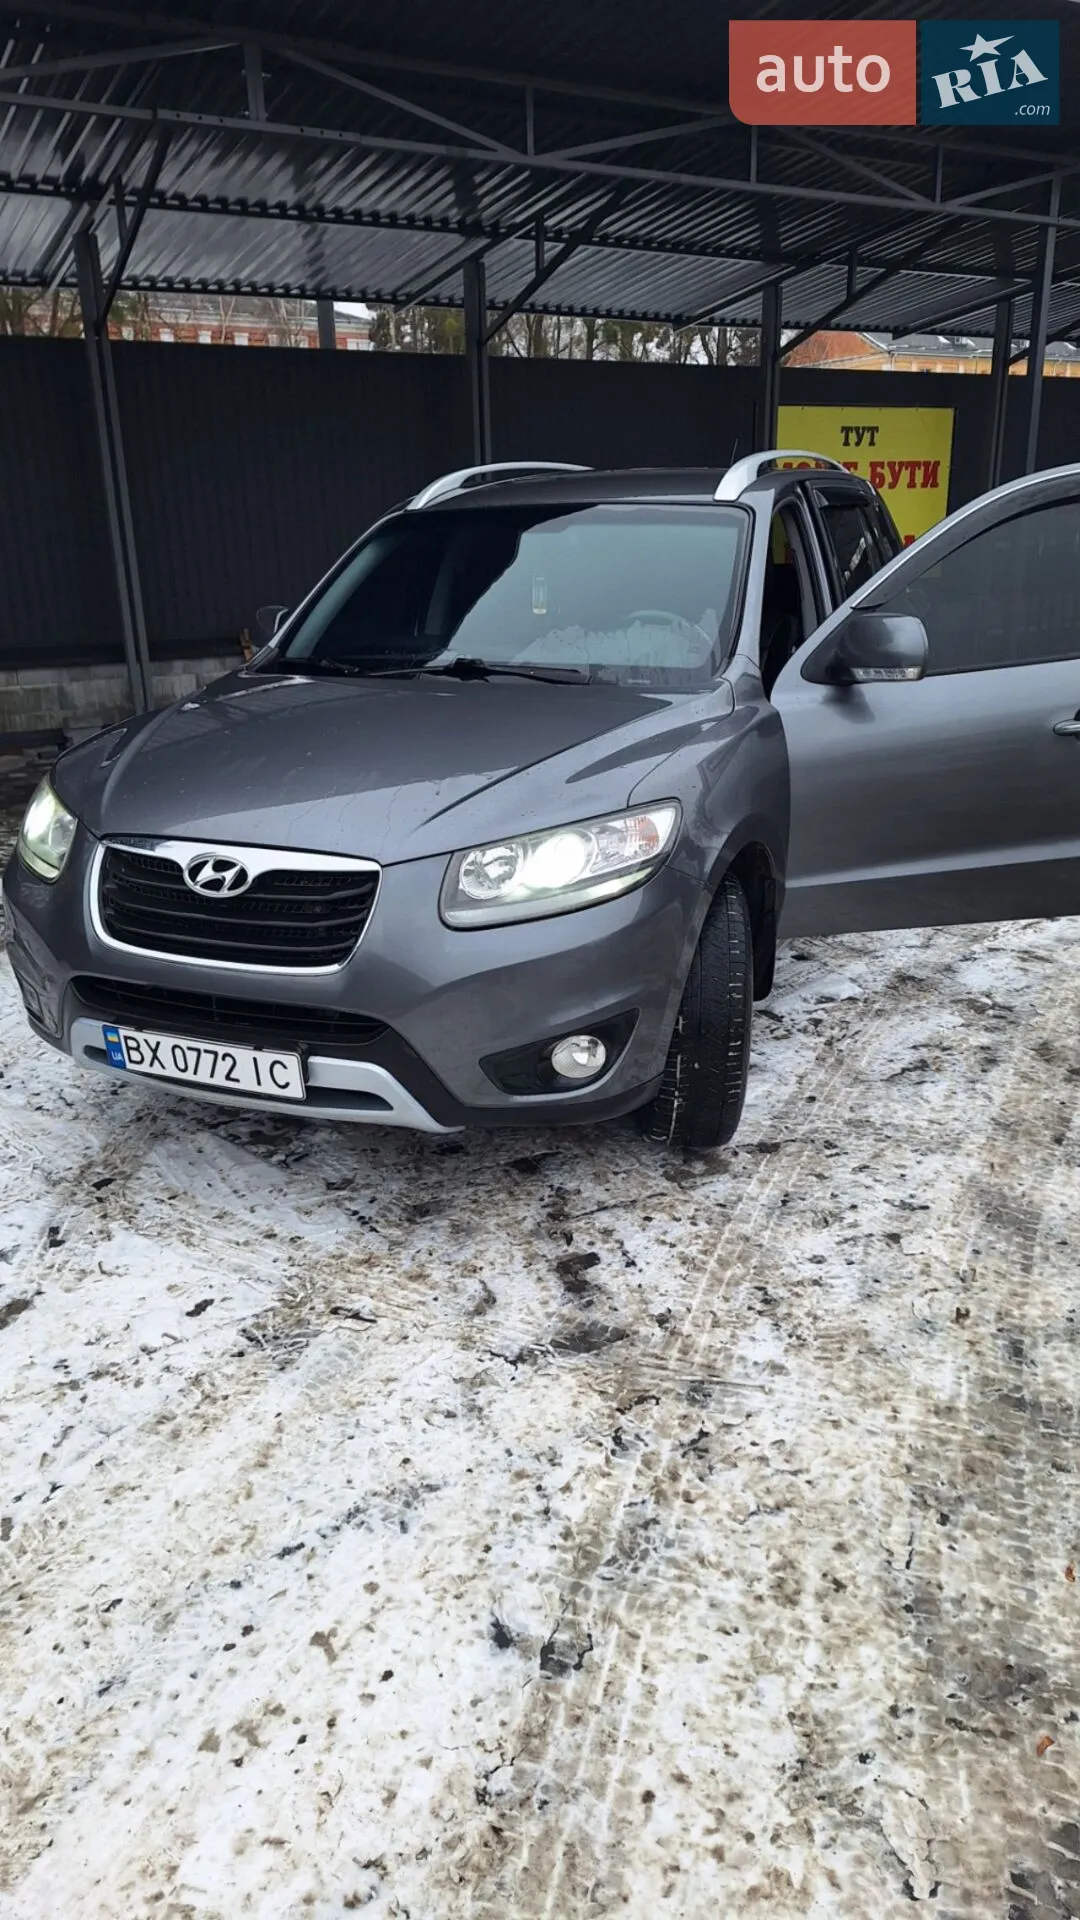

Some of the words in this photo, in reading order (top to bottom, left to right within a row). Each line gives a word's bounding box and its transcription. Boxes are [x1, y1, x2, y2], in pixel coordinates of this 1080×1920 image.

[840, 426, 879, 447] ТУТ
[869, 460, 940, 489] БУТИ
[111, 1050, 123, 1061] UA
[123, 1035, 167, 1070] BX
[171, 1044, 240, 1083] 0772
[252, 1056, 290, 1090] IC
